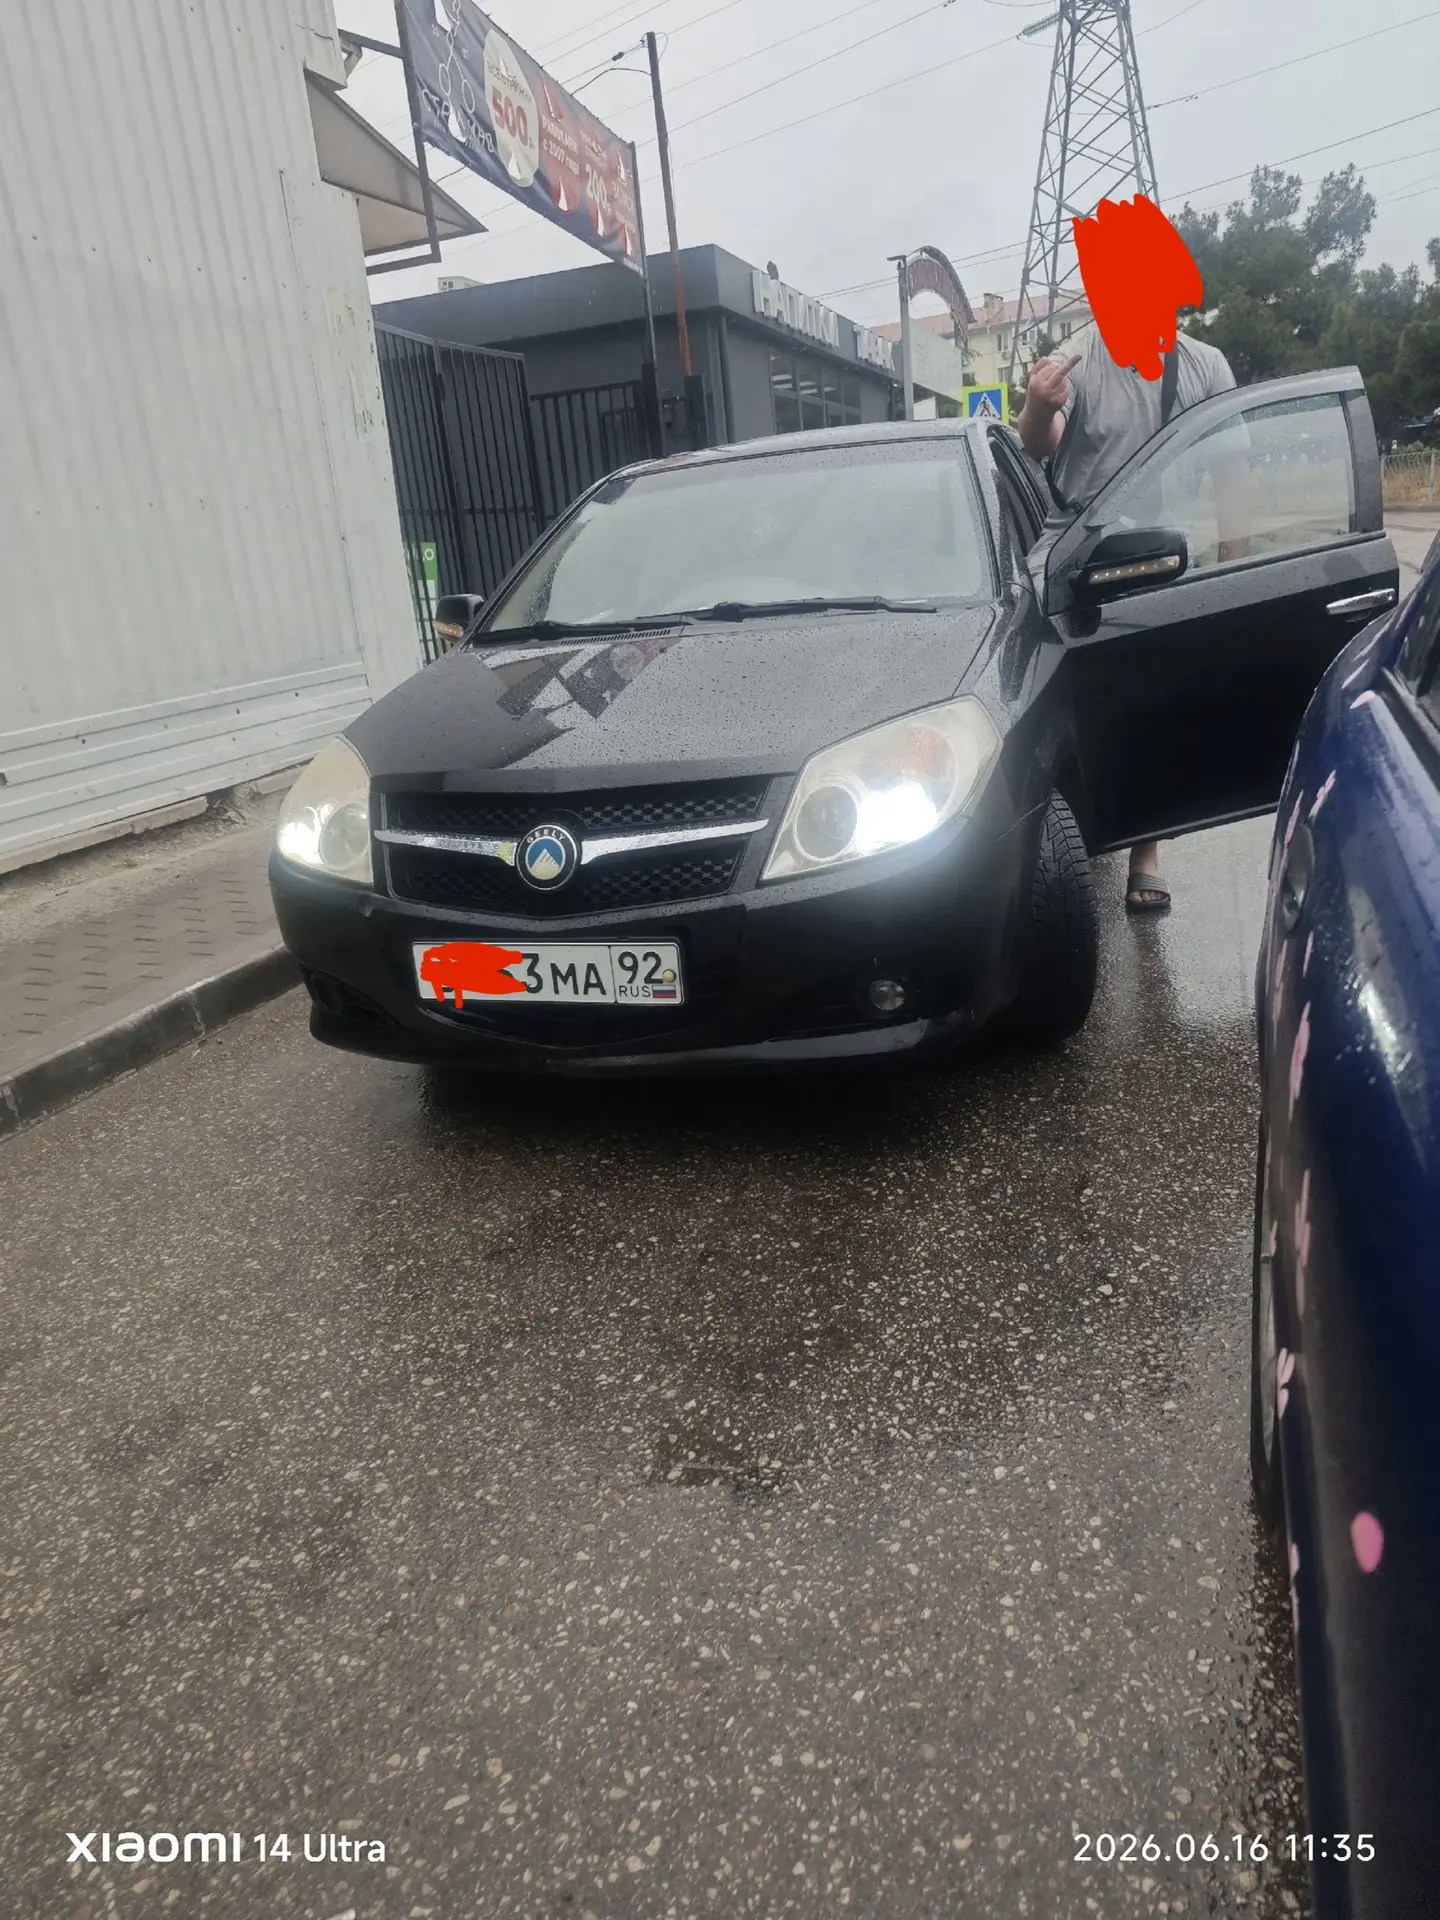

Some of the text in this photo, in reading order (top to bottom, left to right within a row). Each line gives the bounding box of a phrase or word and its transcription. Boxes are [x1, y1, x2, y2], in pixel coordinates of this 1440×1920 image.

[526, 829, 566, 844] GEELY
[618, 951, 664, 984] 92
[619, 985, 651, 998] RUS
